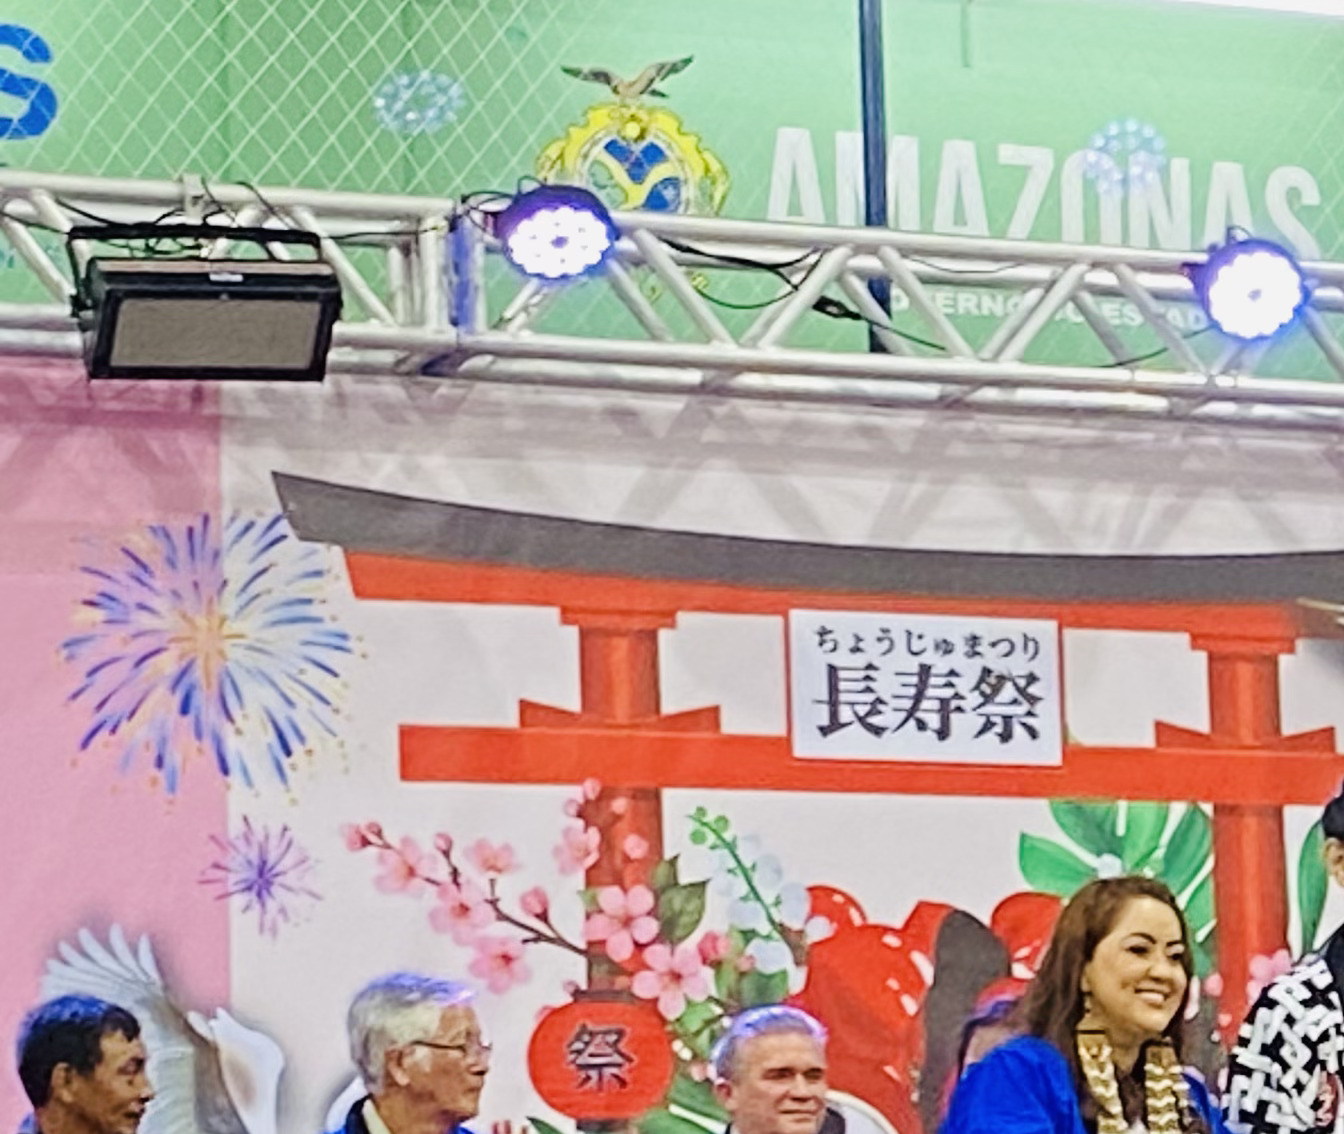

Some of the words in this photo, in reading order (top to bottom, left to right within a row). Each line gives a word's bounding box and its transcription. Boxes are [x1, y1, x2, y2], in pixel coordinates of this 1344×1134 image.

[815, 625, 1041, 662] ちょうじゅまつり
[812, 662, 1044, 744] 長寿祭
[566, 1022, 634, 1092] 祭
